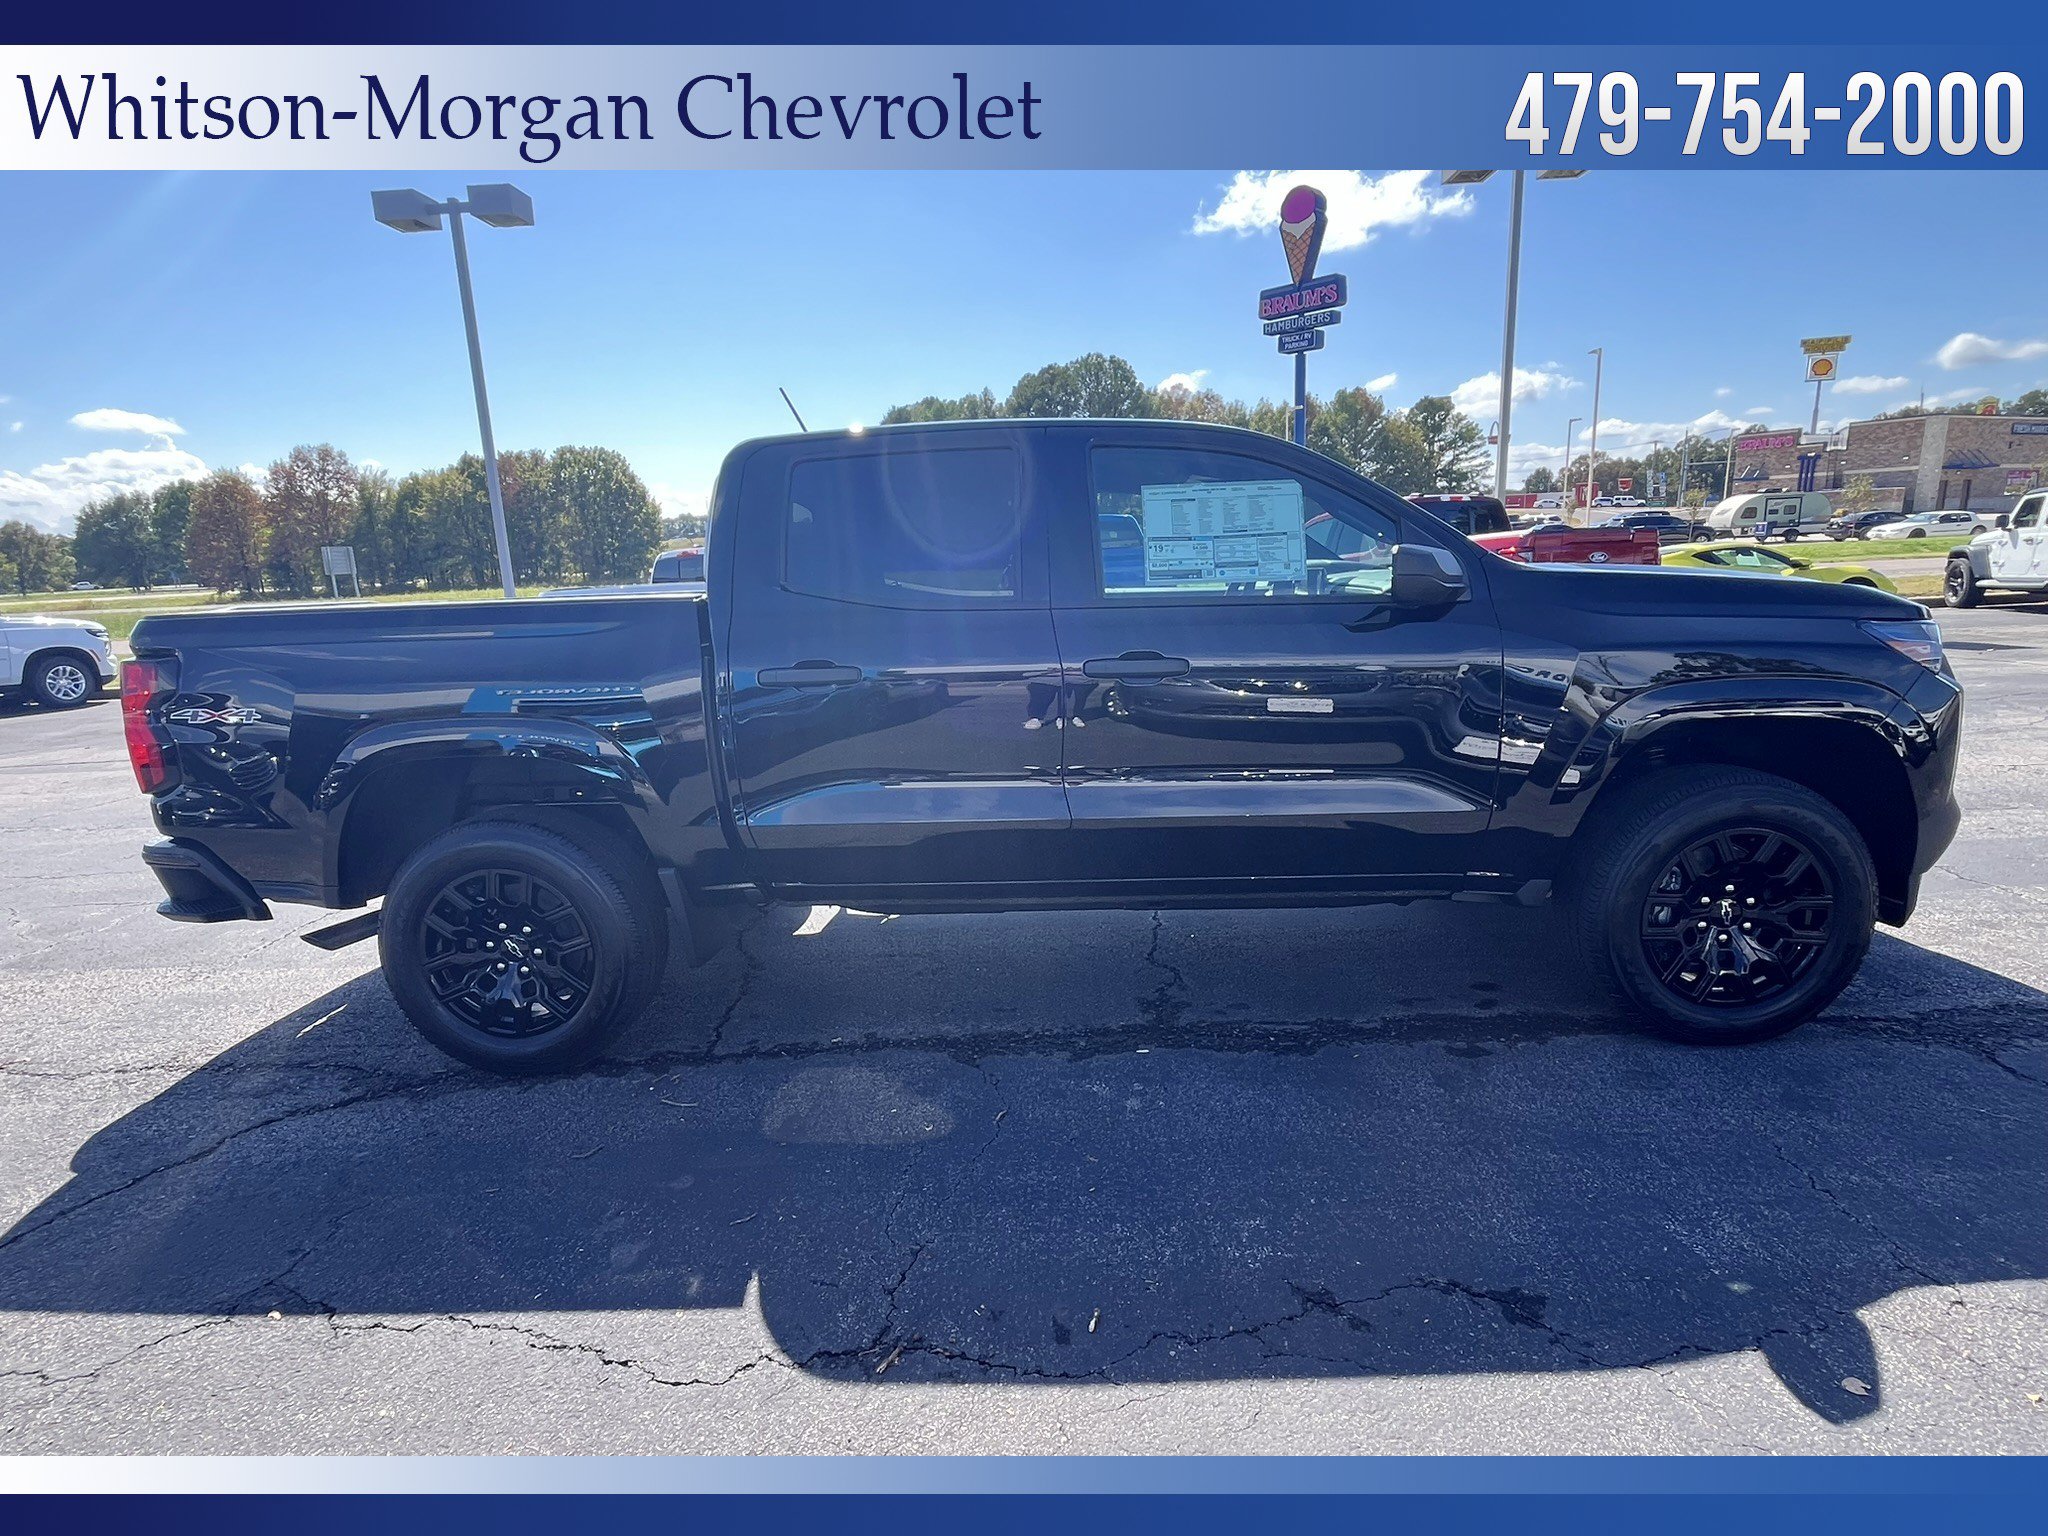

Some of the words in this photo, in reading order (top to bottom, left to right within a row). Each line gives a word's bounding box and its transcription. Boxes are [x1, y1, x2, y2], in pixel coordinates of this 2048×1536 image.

[1261, 284, 1338, 317] BRAUM'S
[1264, 312, 1331, 334] HAMBURGERS
[1282, 334, 1300, 343] TRUCK
[1284, 340, 1309, 349] PARKING
